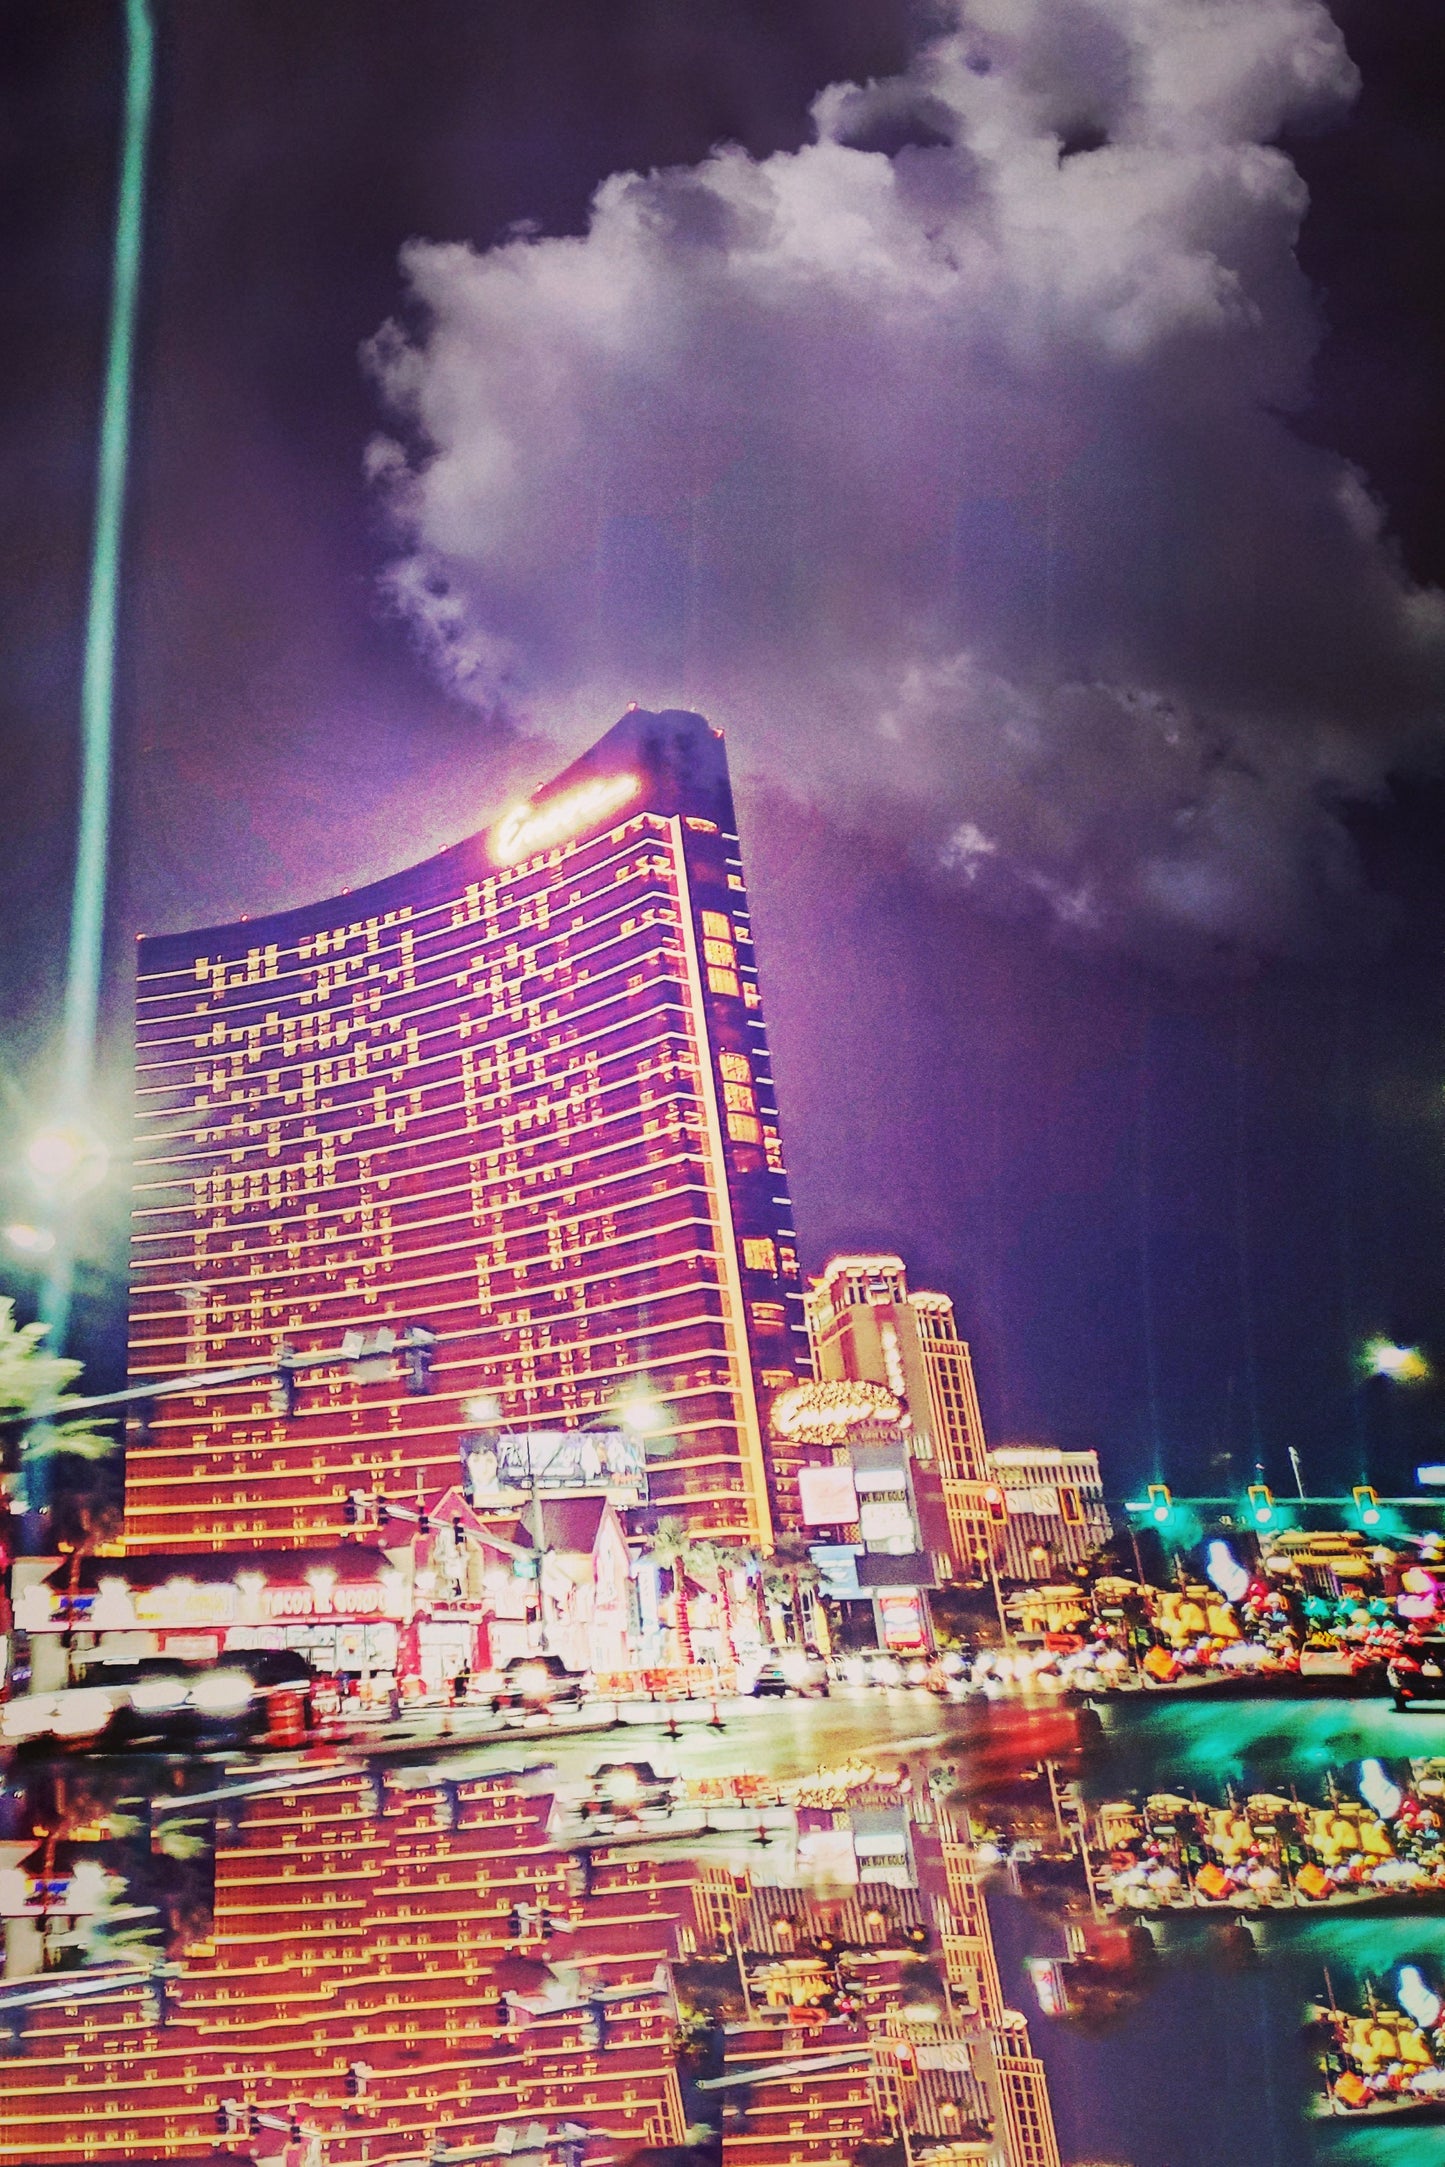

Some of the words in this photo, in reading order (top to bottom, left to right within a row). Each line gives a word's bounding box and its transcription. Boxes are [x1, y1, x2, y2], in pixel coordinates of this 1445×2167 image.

[872, 1491, 886, 1502] BUY
[887, 1490, 906, 1502] GOLD
[264, 1590, 313, 1616] TACOS
